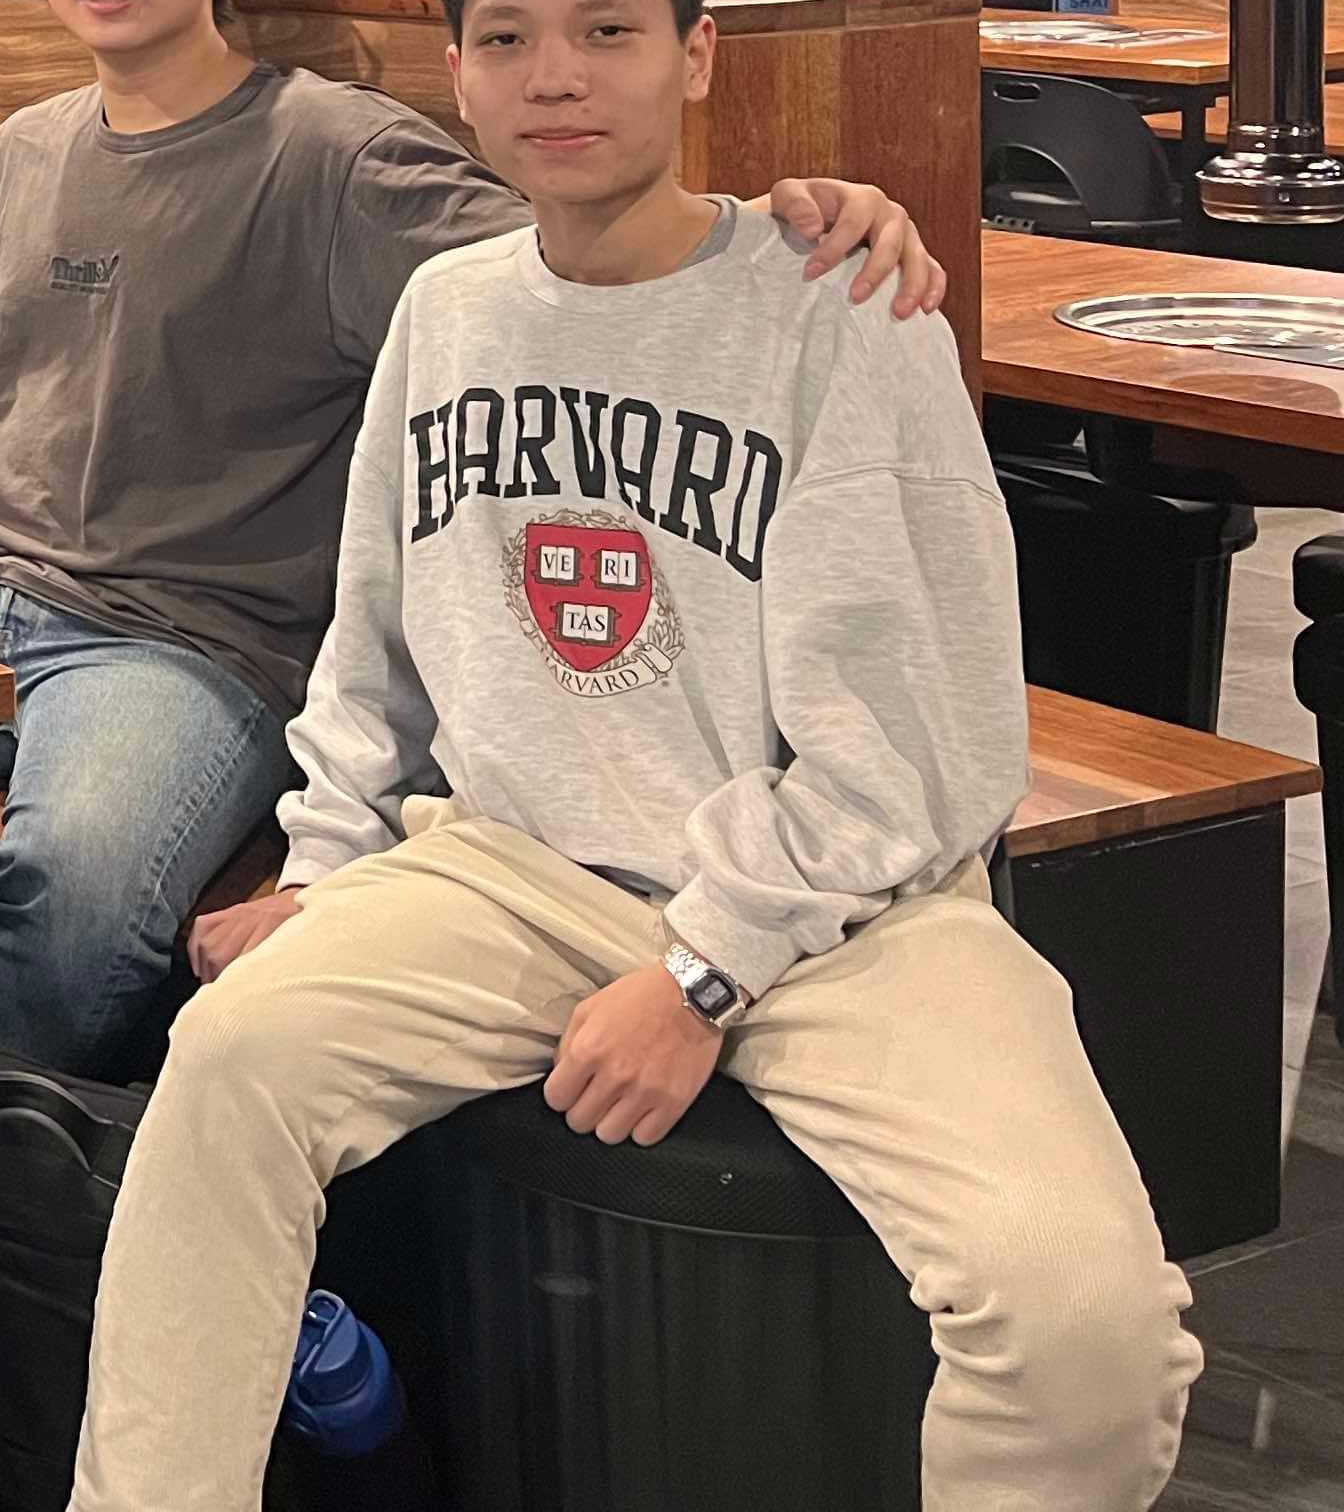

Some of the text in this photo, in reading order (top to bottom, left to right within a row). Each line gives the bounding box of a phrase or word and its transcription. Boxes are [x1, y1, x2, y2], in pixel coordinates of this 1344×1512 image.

[409, 385, 783, 583] HARVARD
[543, 550, 632, 579] VE RI
[566, 612, 606, 634] TAS
[546, 656, 639, 694] ARVARD
